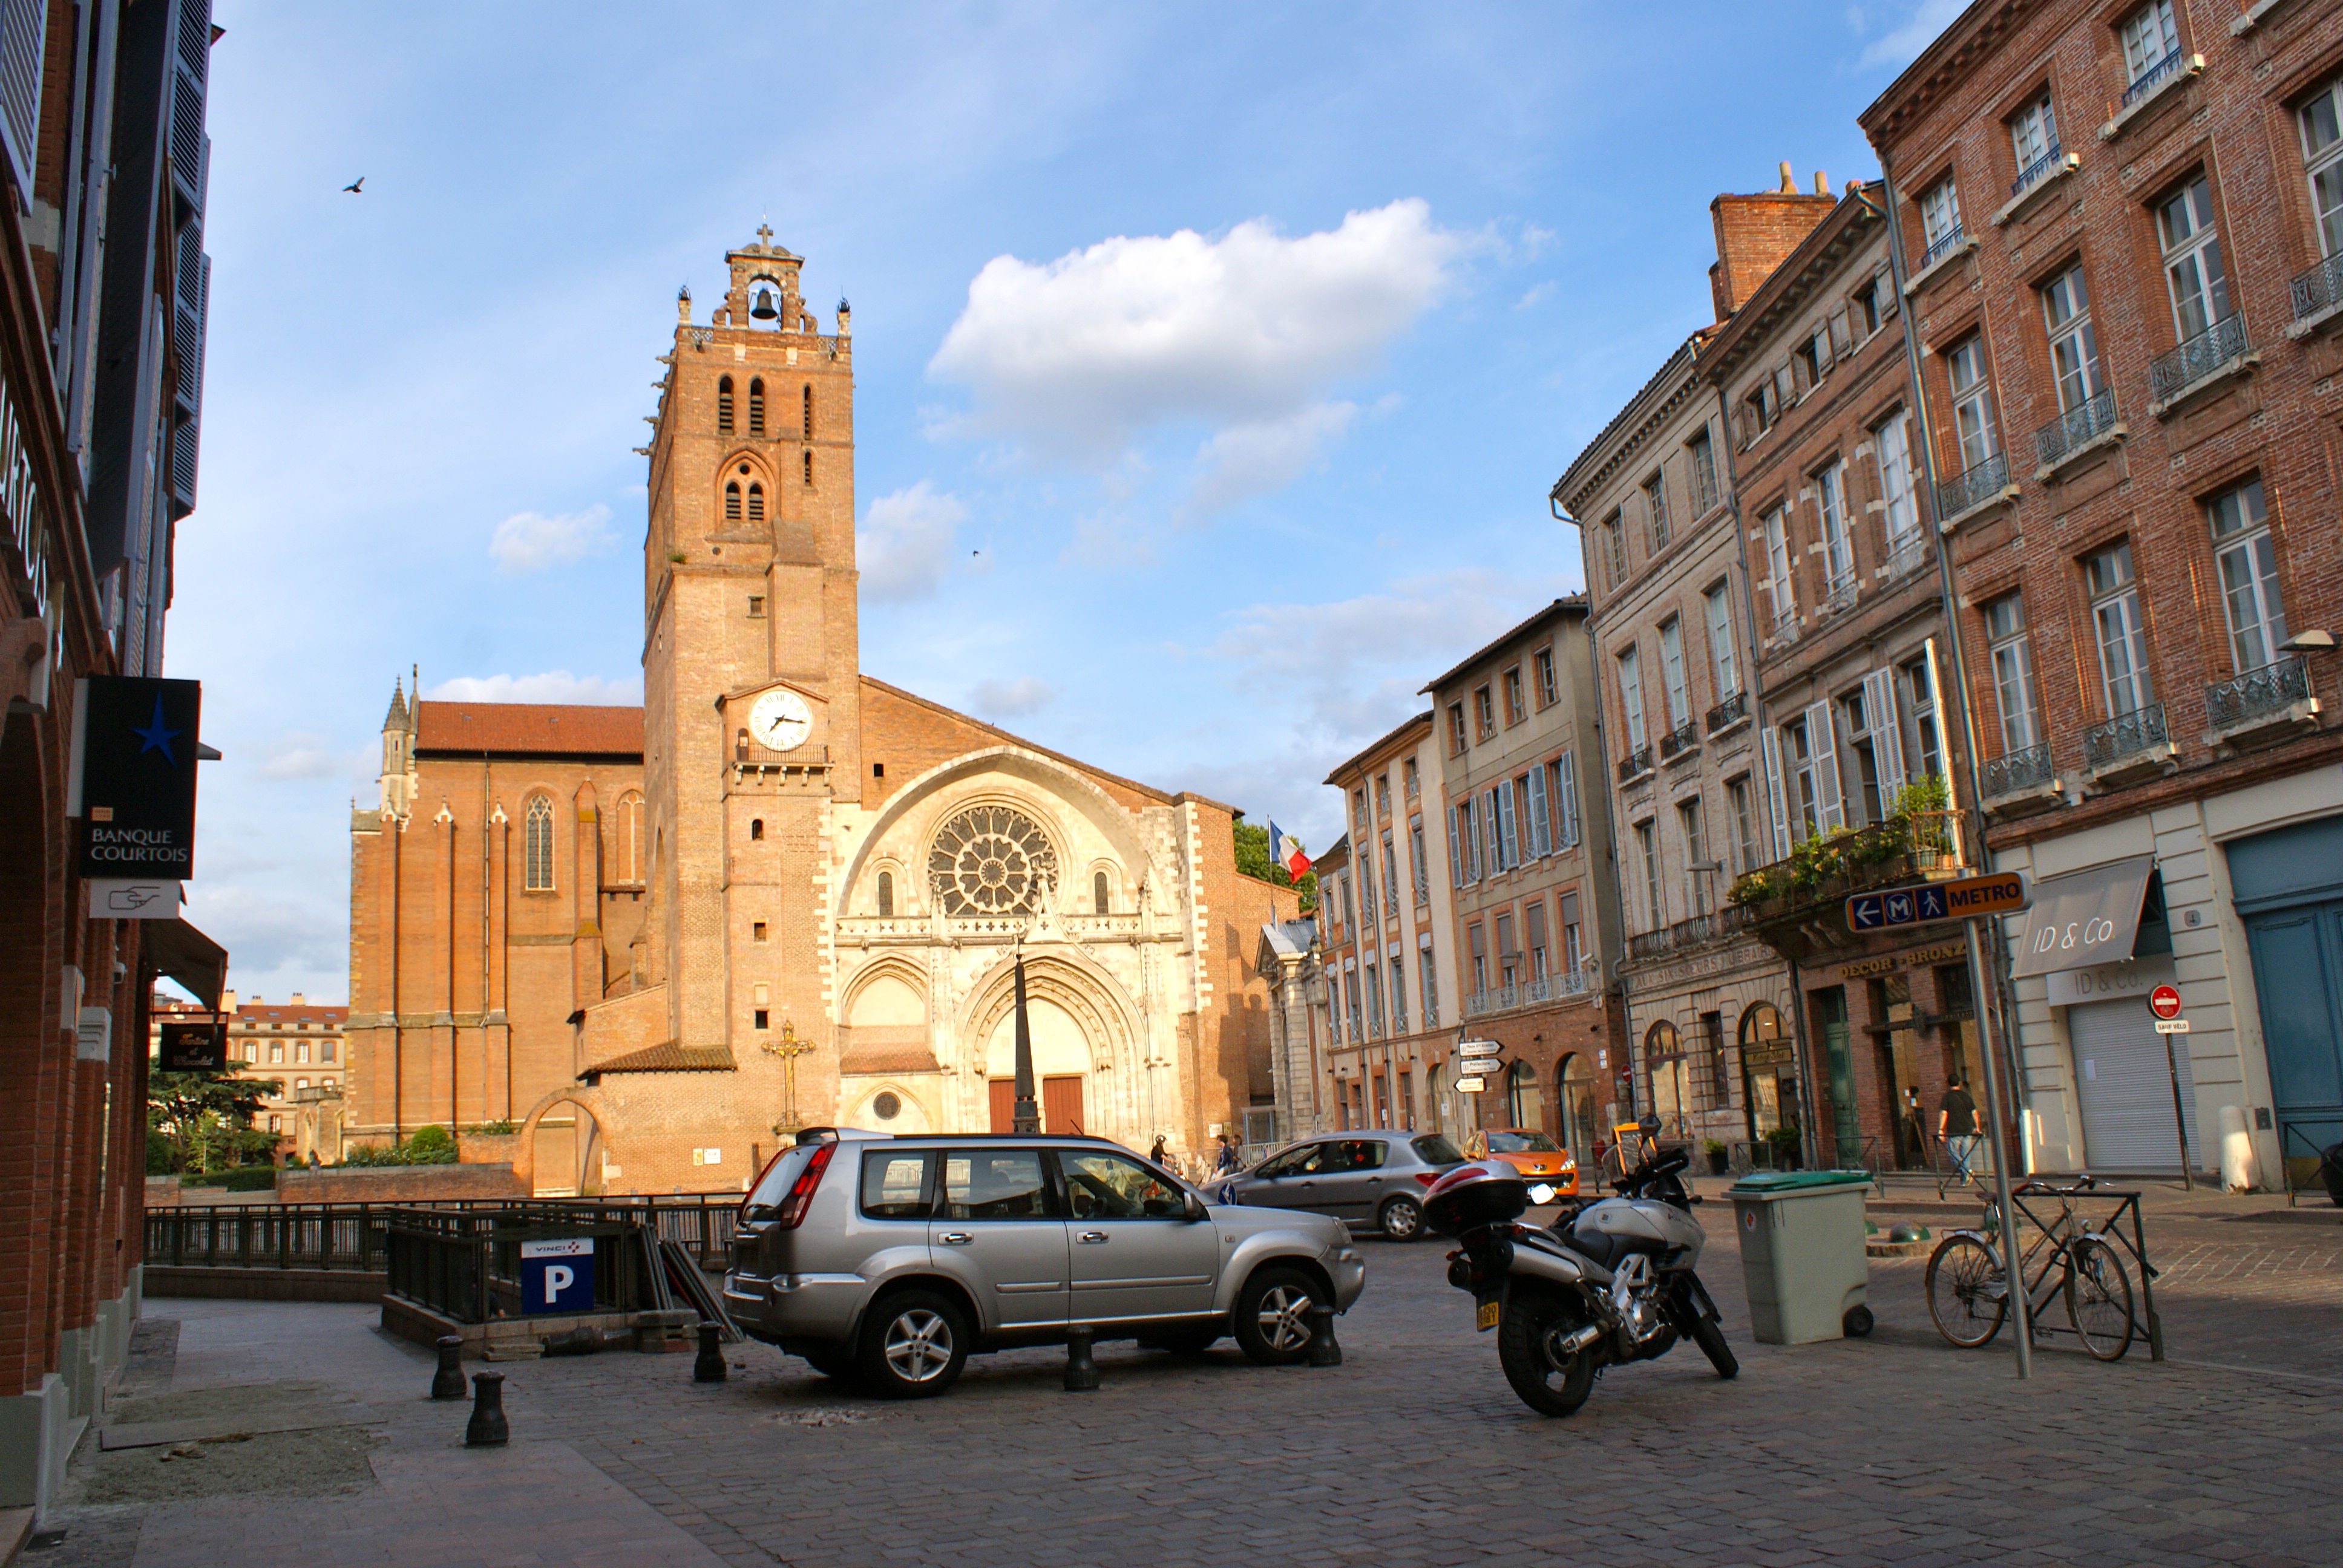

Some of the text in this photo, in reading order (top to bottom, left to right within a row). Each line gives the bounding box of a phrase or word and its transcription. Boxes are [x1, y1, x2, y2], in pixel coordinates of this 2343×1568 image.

[92, 829, 172, 846] BANQUE
[91, 846, 188, 862] COURTOIS
[1949, 882, 2021, 907] METRO
[2033, 926, 2056, 953] ID
[2060, 923, 2078, 949] &
[1635, 972, 1654, 988] AUX
[1657, 967, 1673, 984] SIX
[2074, 973, 2092, 995] ID
[2099, 970, 2111, 992] &
[545, 1265, 574, 1304] P
